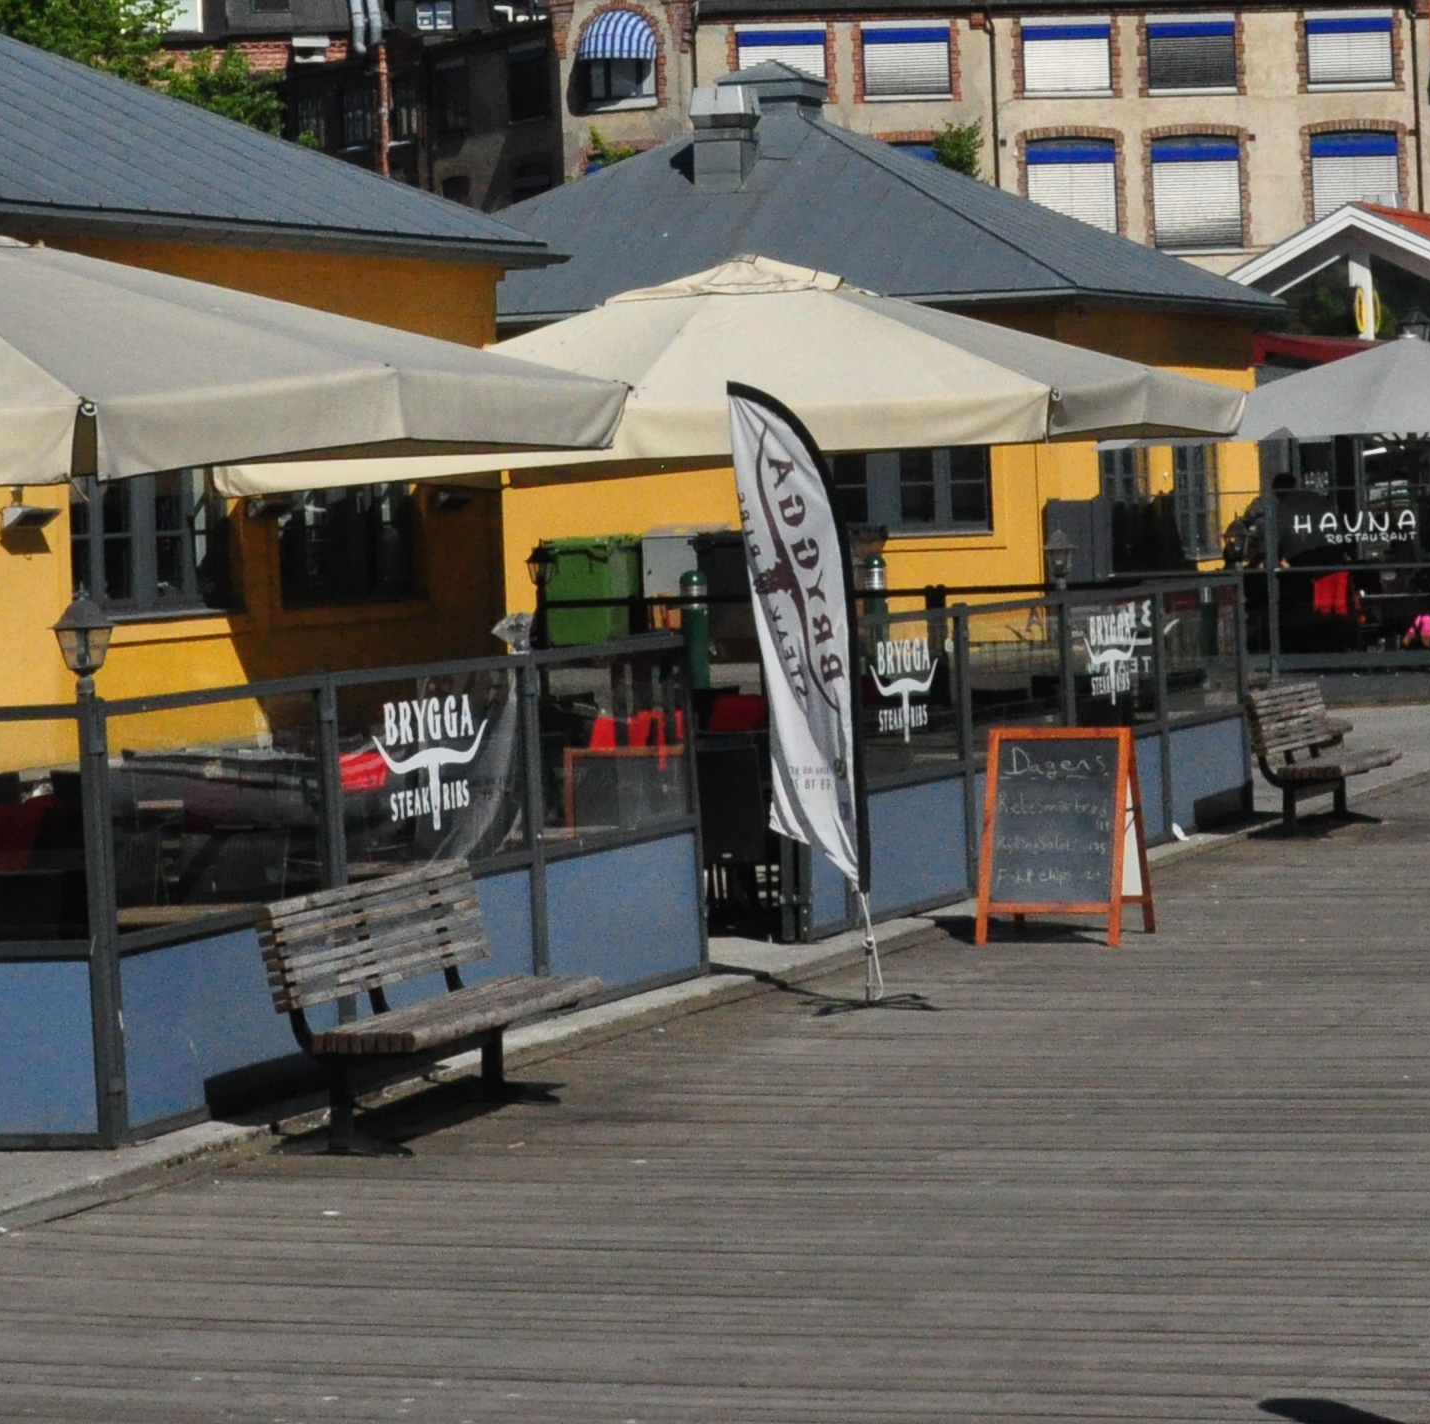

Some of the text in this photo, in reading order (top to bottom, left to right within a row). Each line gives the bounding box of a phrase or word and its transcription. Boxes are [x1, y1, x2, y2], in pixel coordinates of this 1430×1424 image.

[1325, 531, 1417, 544] RESTAURANT
[1089, 612, 1132, 646] BRYGGA
[876, 637, 930, 676] BRYGGA
[383, 694, 475, 746] BRYGGA
[878, 704, 928, 732] STEAK RIBS
[390, 779, 470, 822] STEAK RIBS
